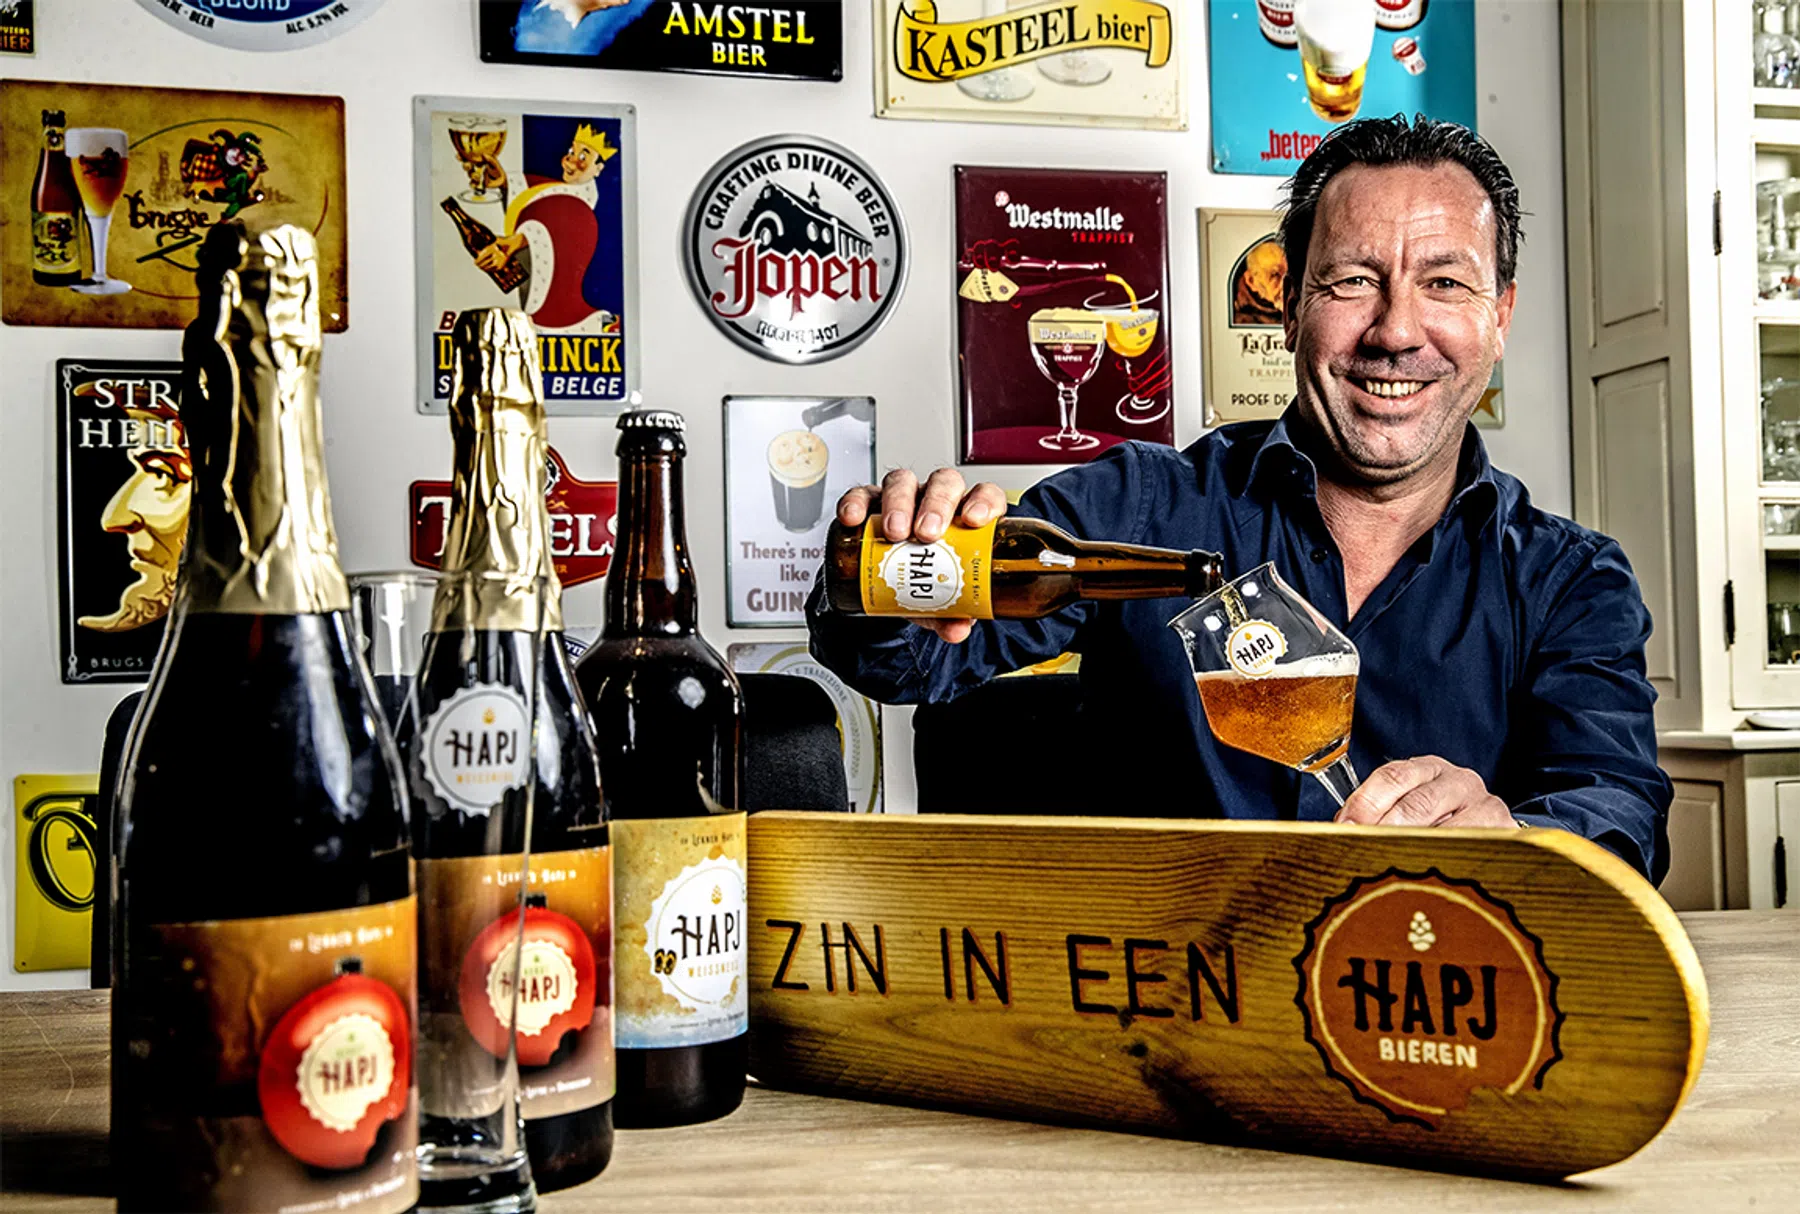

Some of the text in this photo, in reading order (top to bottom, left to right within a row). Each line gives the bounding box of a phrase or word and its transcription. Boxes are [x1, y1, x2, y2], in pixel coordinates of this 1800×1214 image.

[663, 1, 815, 44] AMSTEL
[0, 35, 31, 49] IER
[712, 41, 767, 66] BIER
[907, 6, 1145, 80] KASTEEL bier
[705, 152, 889, 239] CRAFTING DIVINE BEER
[1005, 203, 1124, 231] Westmalle
[1071, 232, 1134, 243] TRAPPIST
[711, 236, 882, 321] Jopen
[551, 376, 621, 396] BELGE
[1231, 393, 1289, 407] PROEF DE
[740, 541, 797, 560] There's
[780, 563, 811, 582] like
[910, 548, 936, 600] HAPJ
[1235, 633, 1275, 666] HAPJ
[443, 728, 518, 768] HAPJ
[671, 909, 741, 960] HAPJ
[939, 926, 1012, 1007] IN
[1065, 934, 1241, 1025] EEN
[1337, 956, 1498, 1041] HAPJ
[1378, 1037, 1478, 1069] BIEREN
[315, 1054, 379, 1093] HAPJ
